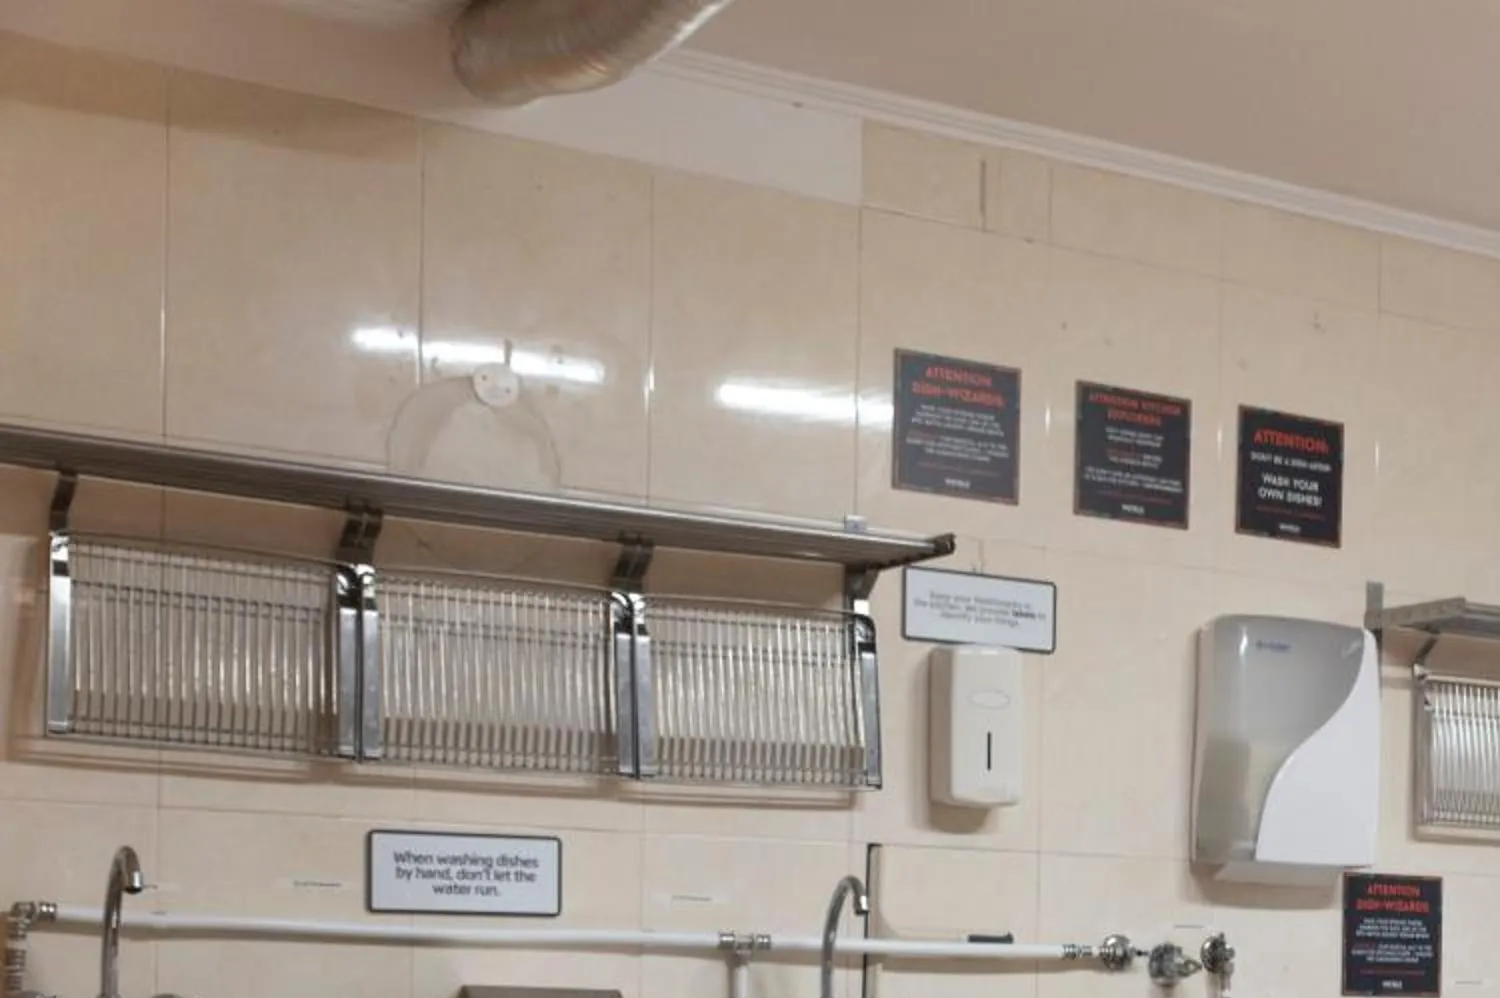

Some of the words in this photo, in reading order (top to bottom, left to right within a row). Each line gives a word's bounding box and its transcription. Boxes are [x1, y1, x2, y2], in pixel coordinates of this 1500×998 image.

[393, 850, 434, 866] When
[436, 852, 493, 868] washing
[496, 854, 540, 868] dishes
[395, 866, 412, 882] by
[415, 866, 454, 881] hand,
[456, 868, 491, 881] don't
[494, 869, 511, 882] let
[514, 870, 538, 883] the
[432, 884, 472, 896] water
[474, 885, 501, 896] run.
